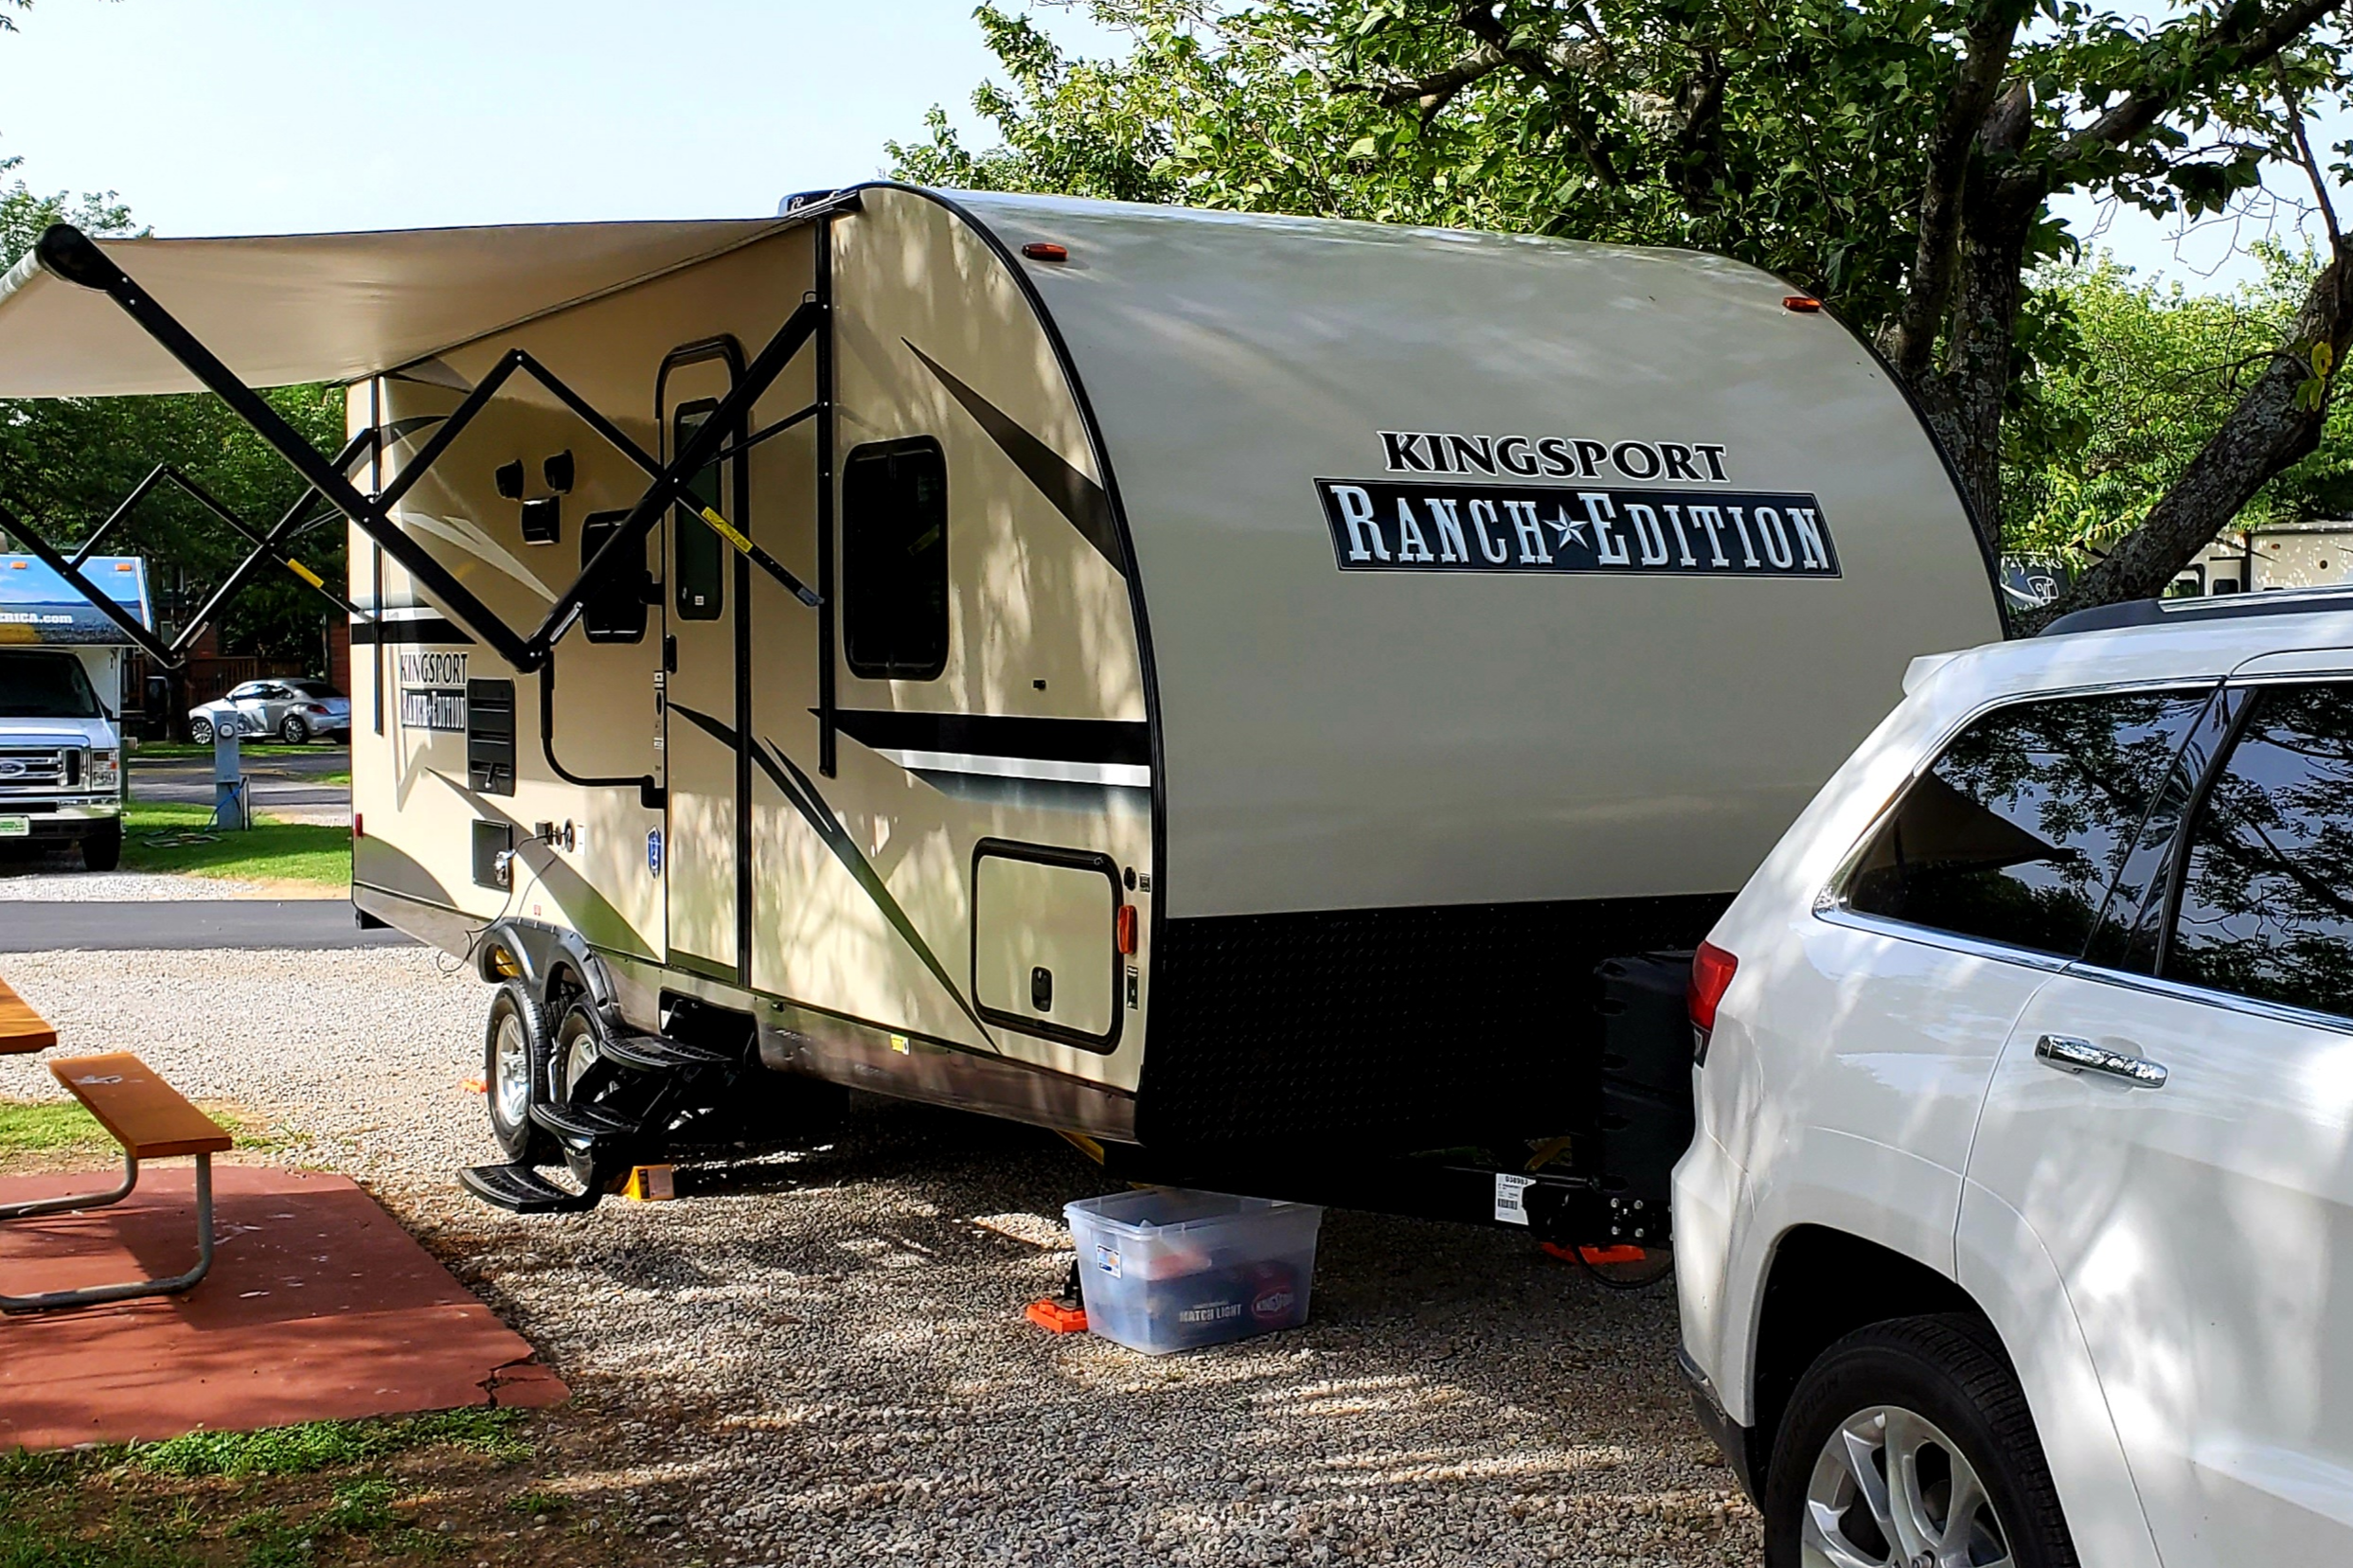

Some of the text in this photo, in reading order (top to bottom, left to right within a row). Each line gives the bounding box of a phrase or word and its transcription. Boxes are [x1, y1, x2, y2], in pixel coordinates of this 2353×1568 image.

[1377, 431, 1730, 483] KINGSPORT
[1328, 485, 1829, 569] RANCH EDITION
[401, 652, 469, 684] KINGSPORT
[1179, 1307, 1215, 1323] MATCH
[1216, 1303, 1242, 1319] LIGHT
